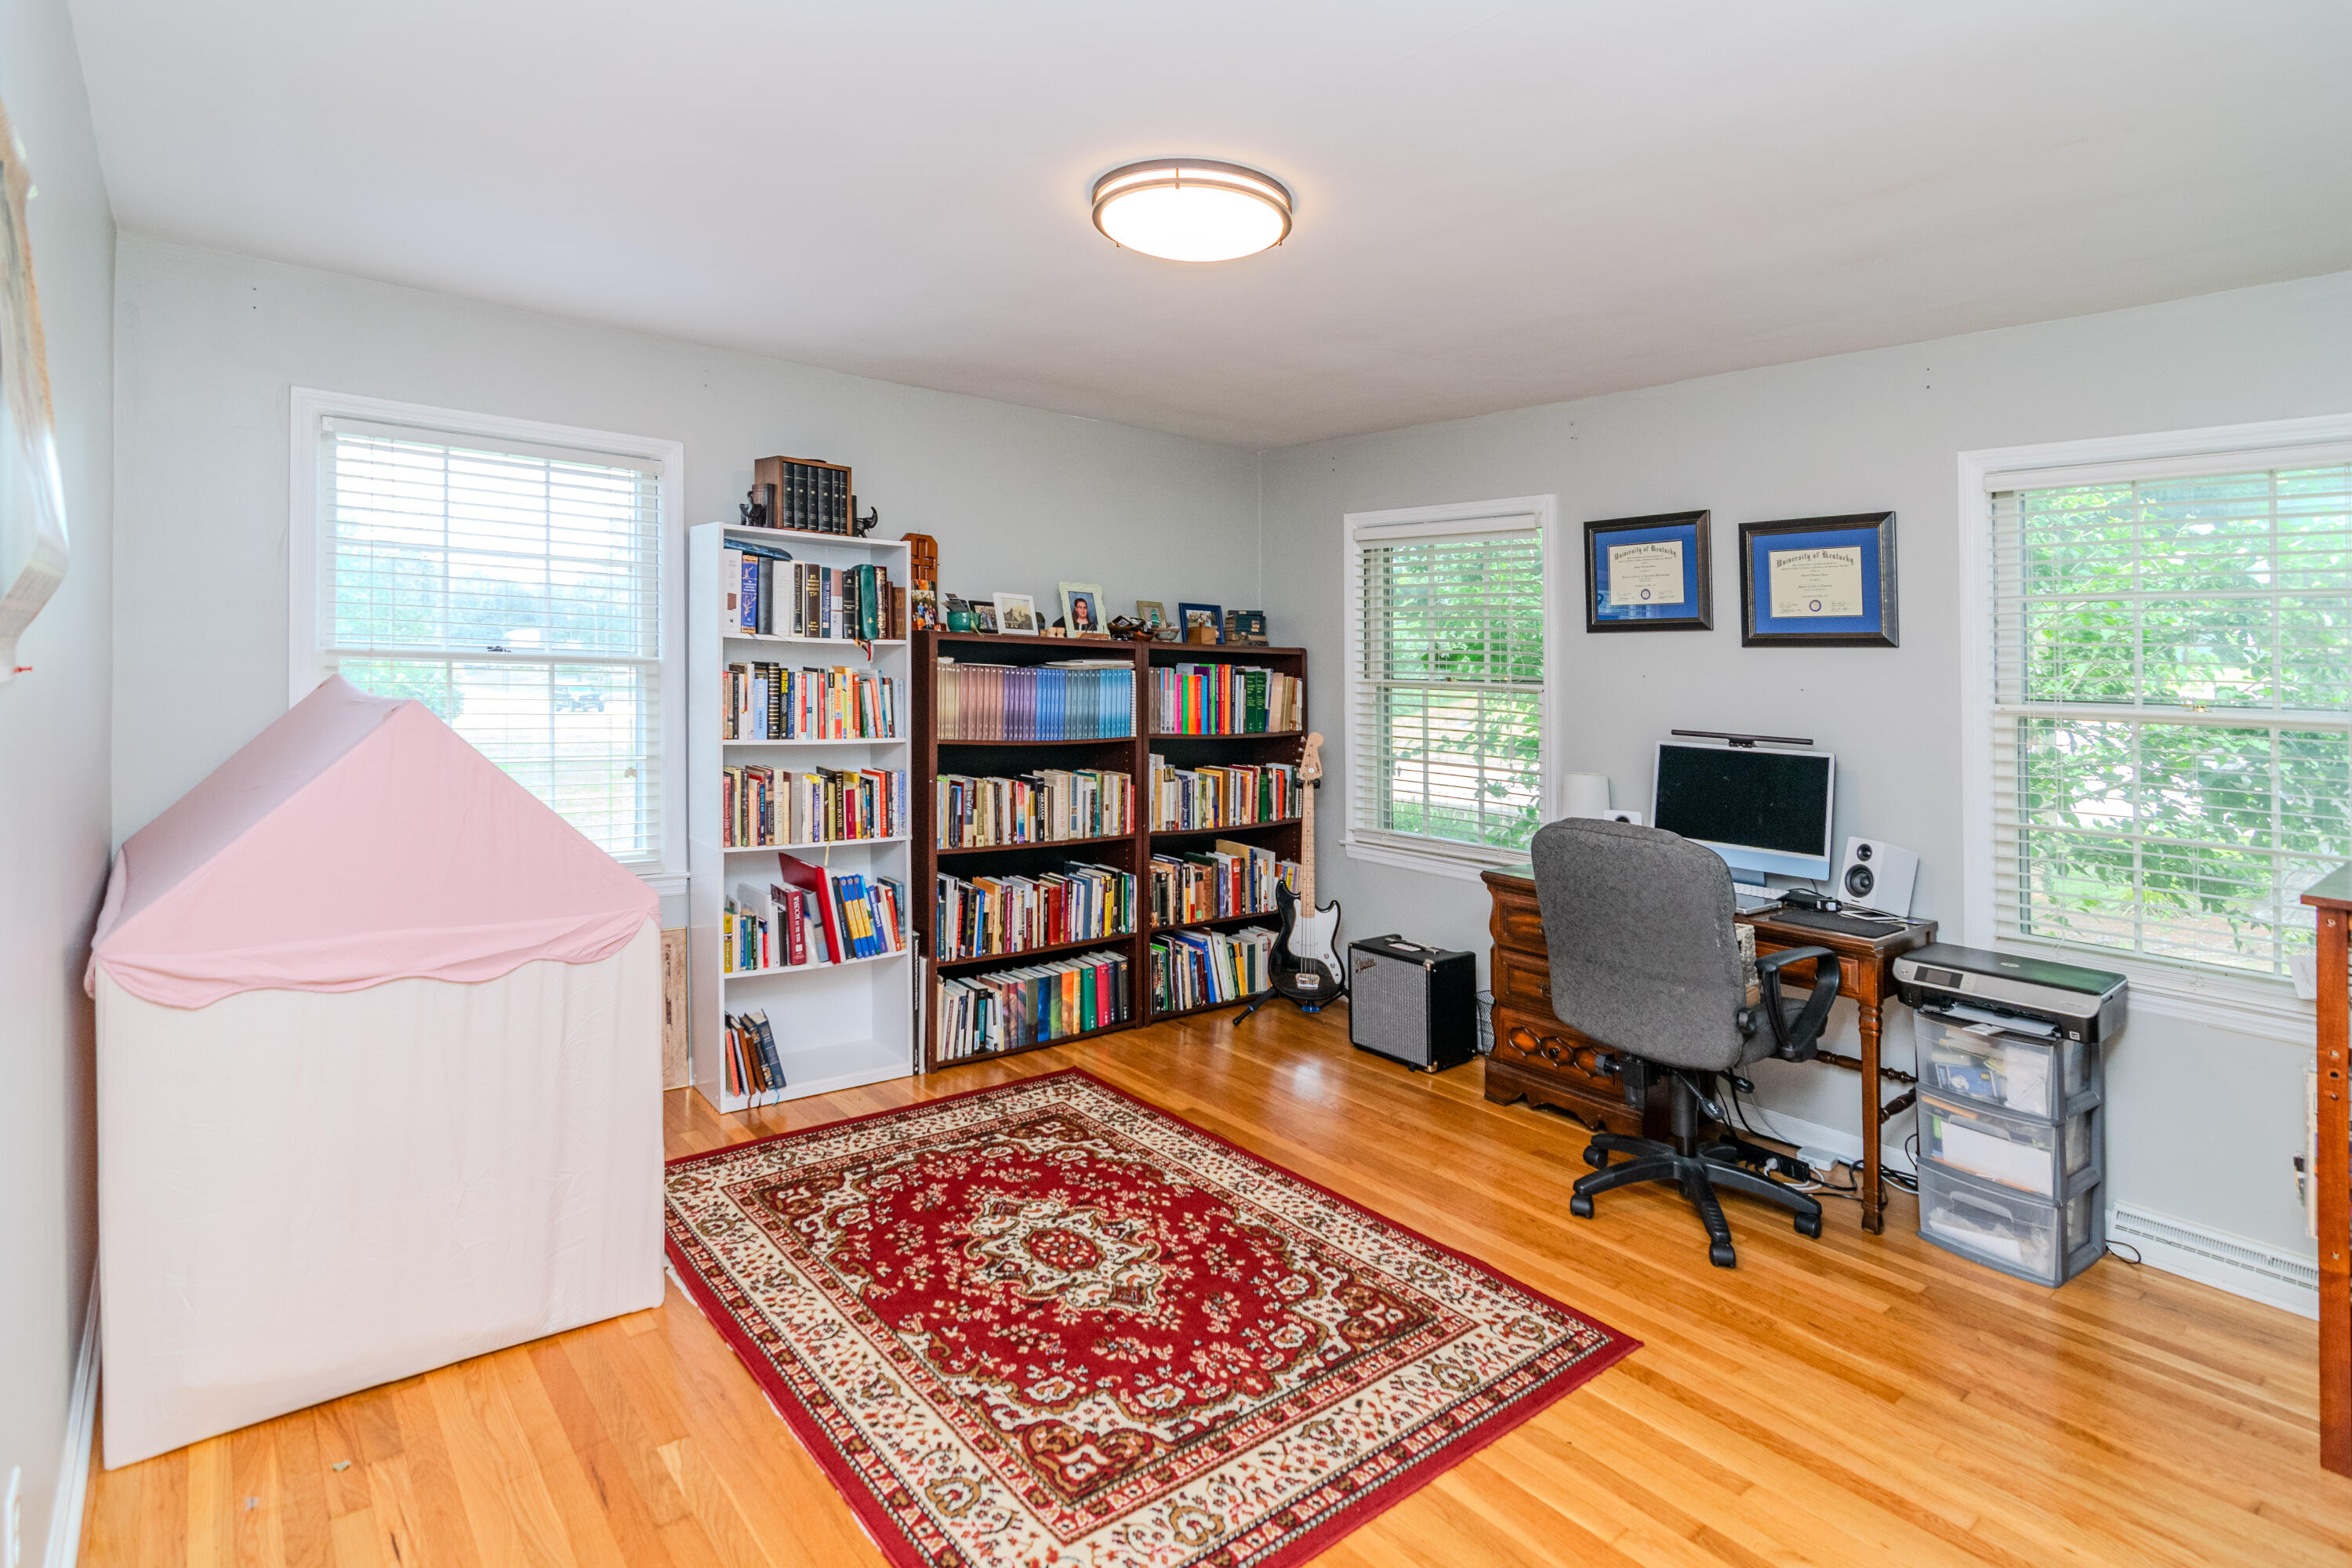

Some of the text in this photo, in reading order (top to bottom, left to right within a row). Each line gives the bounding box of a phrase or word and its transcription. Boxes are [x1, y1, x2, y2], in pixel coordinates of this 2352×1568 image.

[1614, 547, 1642, 560] University
[1650, 544, 1676, 557] Kentucky
[1777, 552, 1811, 568] University
[1822, 550, 1854, 565] Kentucky
[1355, 956, 1377, 975] Fender
